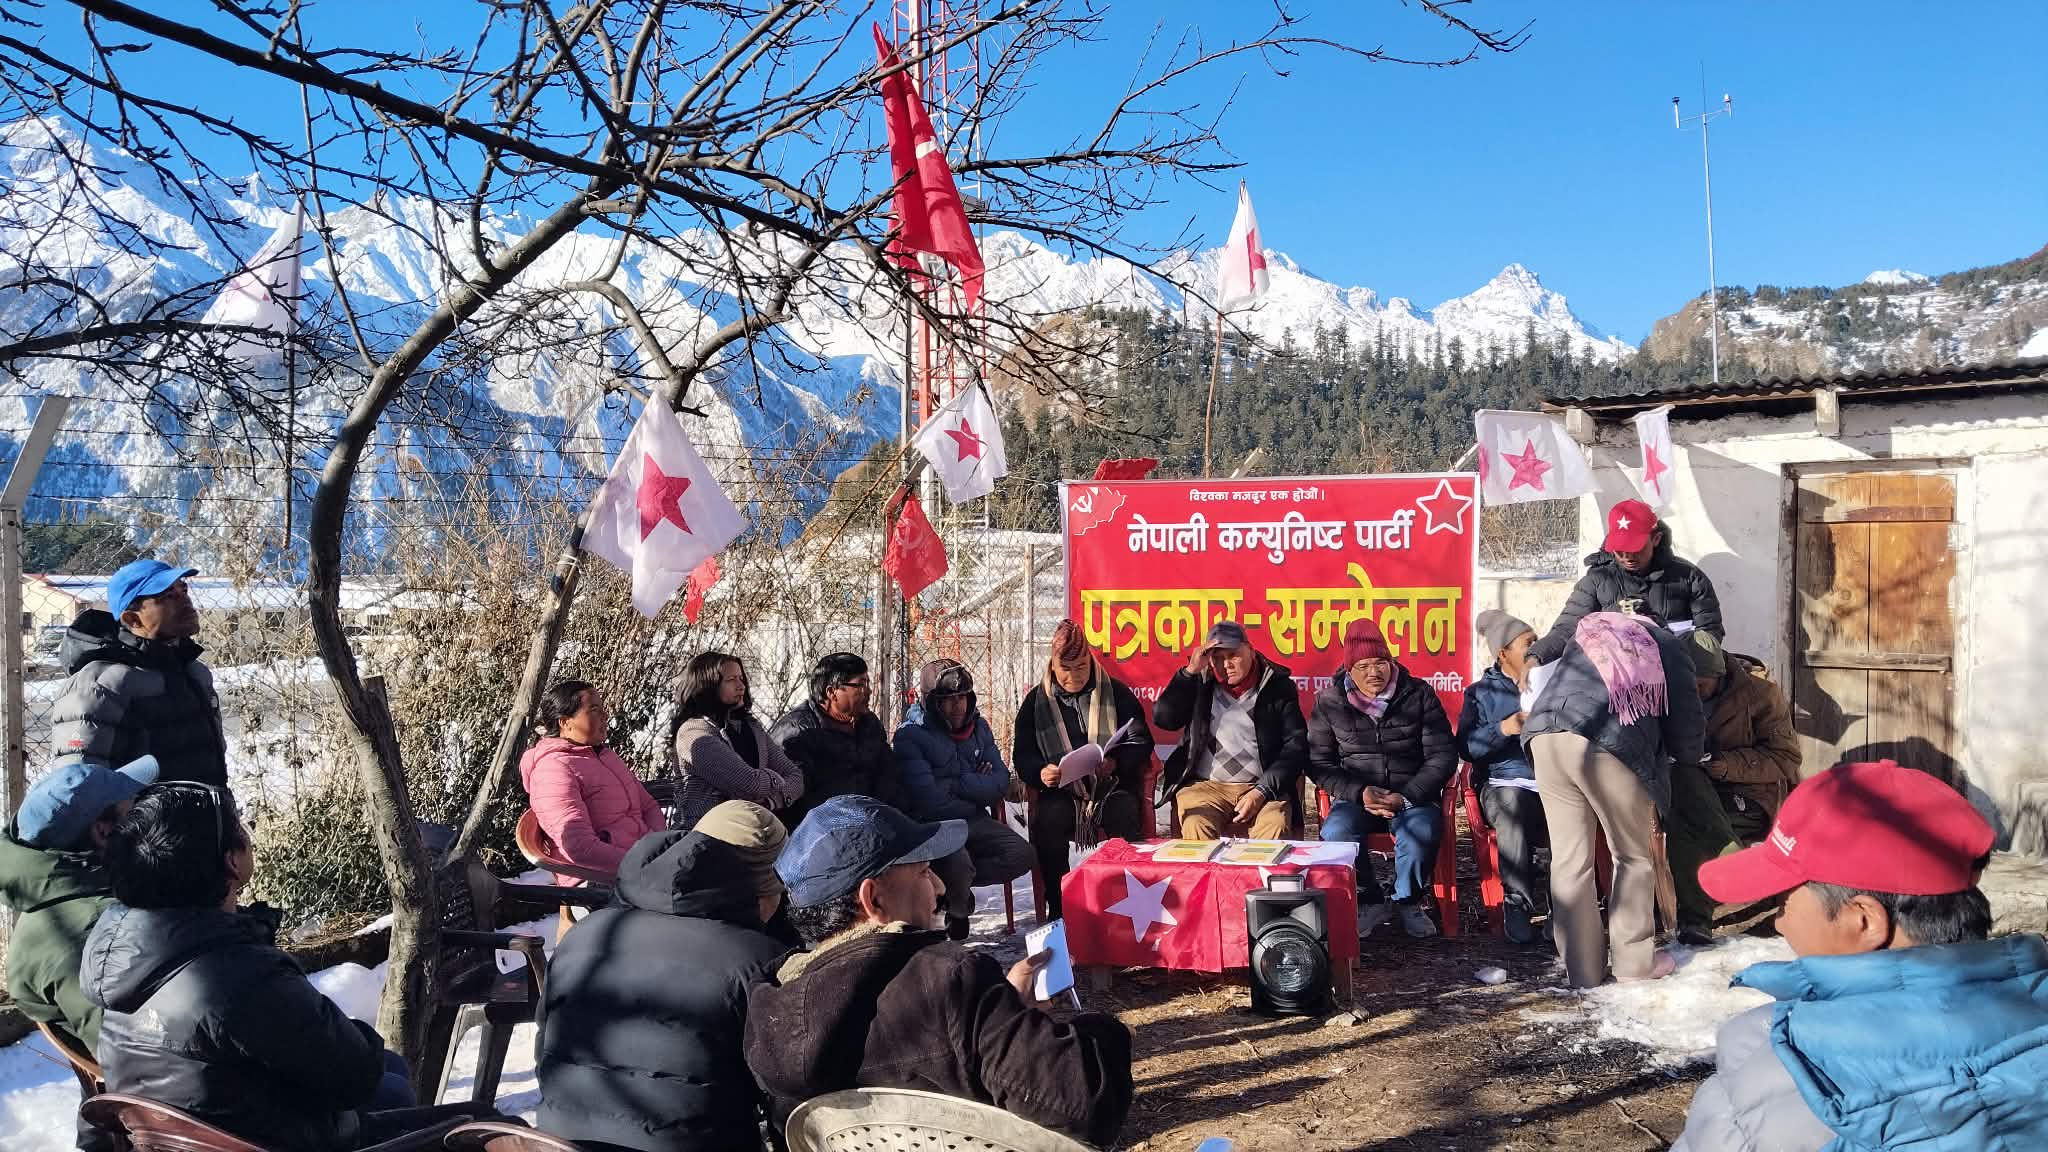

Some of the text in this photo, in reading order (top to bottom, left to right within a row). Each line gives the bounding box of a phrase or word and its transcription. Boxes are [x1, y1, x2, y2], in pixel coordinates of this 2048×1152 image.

[1269, 490, 1290, 501] एक
[1127, 509, 1416, 564] नेपाली कम्युनिष्ट पार्टी
